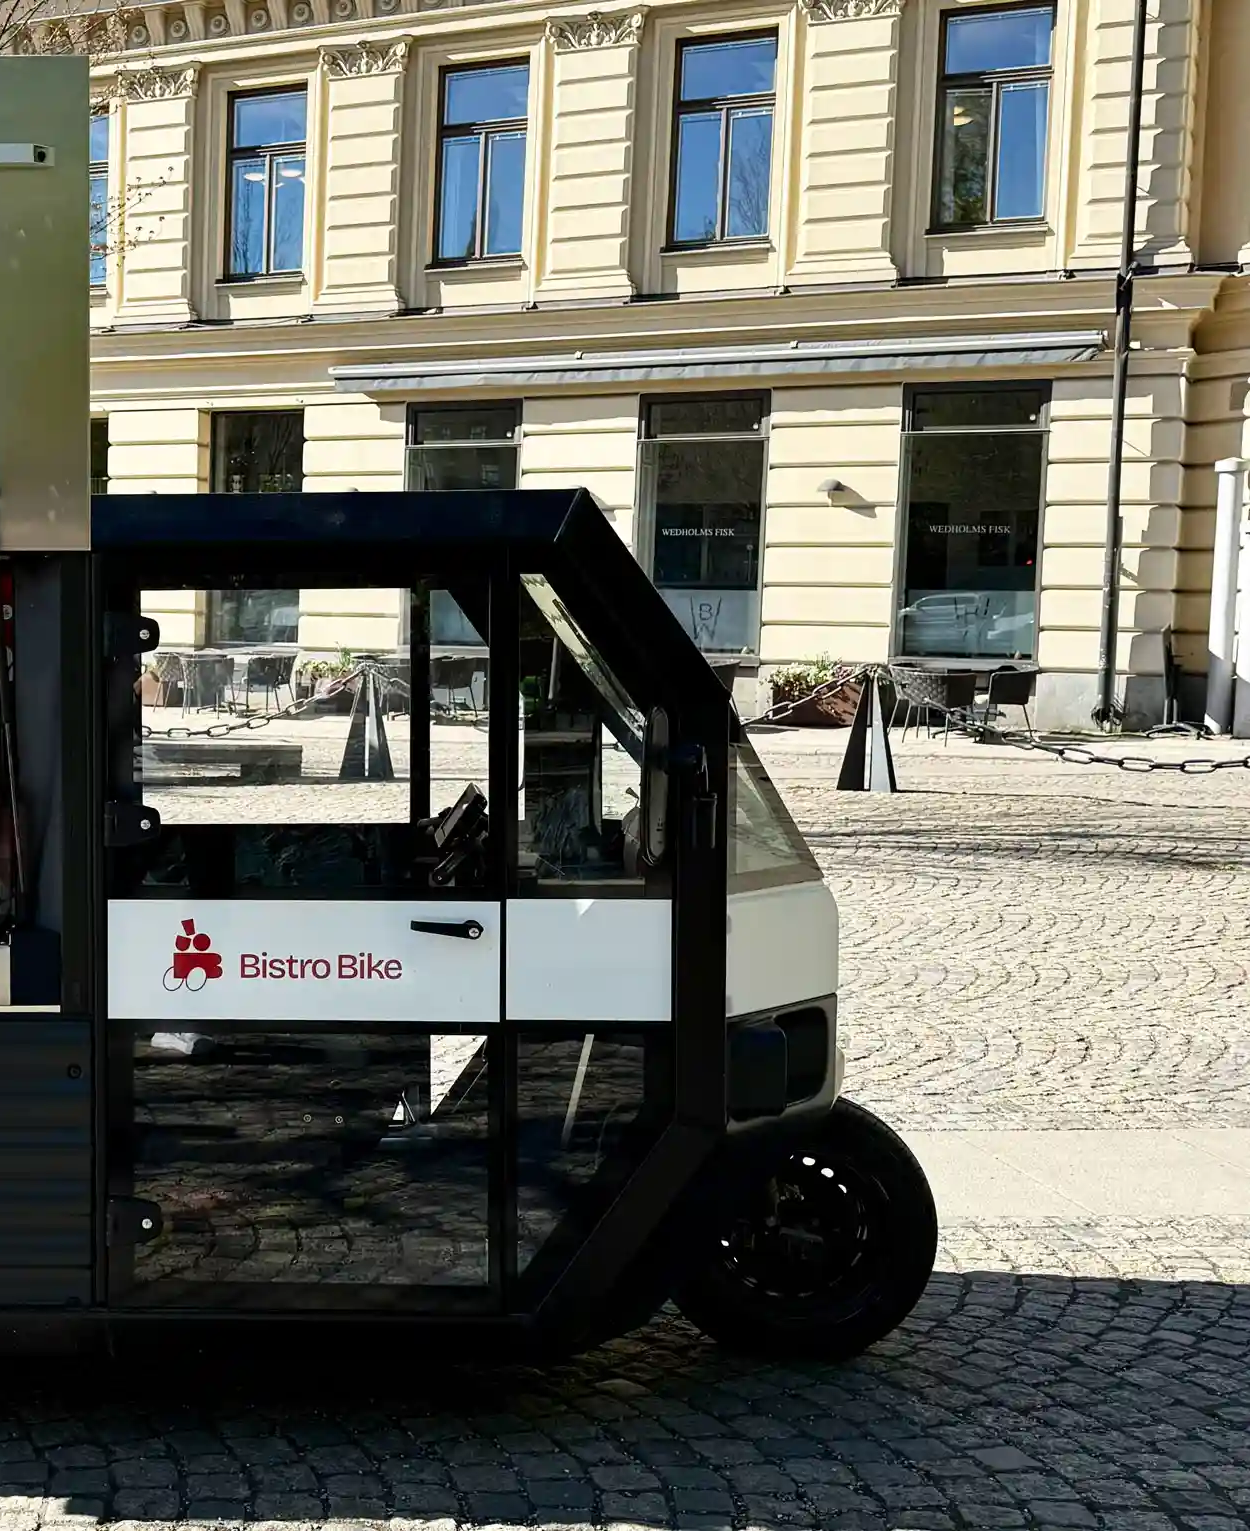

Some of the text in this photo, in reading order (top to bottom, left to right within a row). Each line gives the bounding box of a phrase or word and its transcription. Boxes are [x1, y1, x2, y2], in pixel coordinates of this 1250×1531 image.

[662, 528, 735, 536] WEDHOLMS FISK
[930, 525, 1011, 534] WEDHOLMS FISK
[240, 952, 403, 979] Bistro Bike
